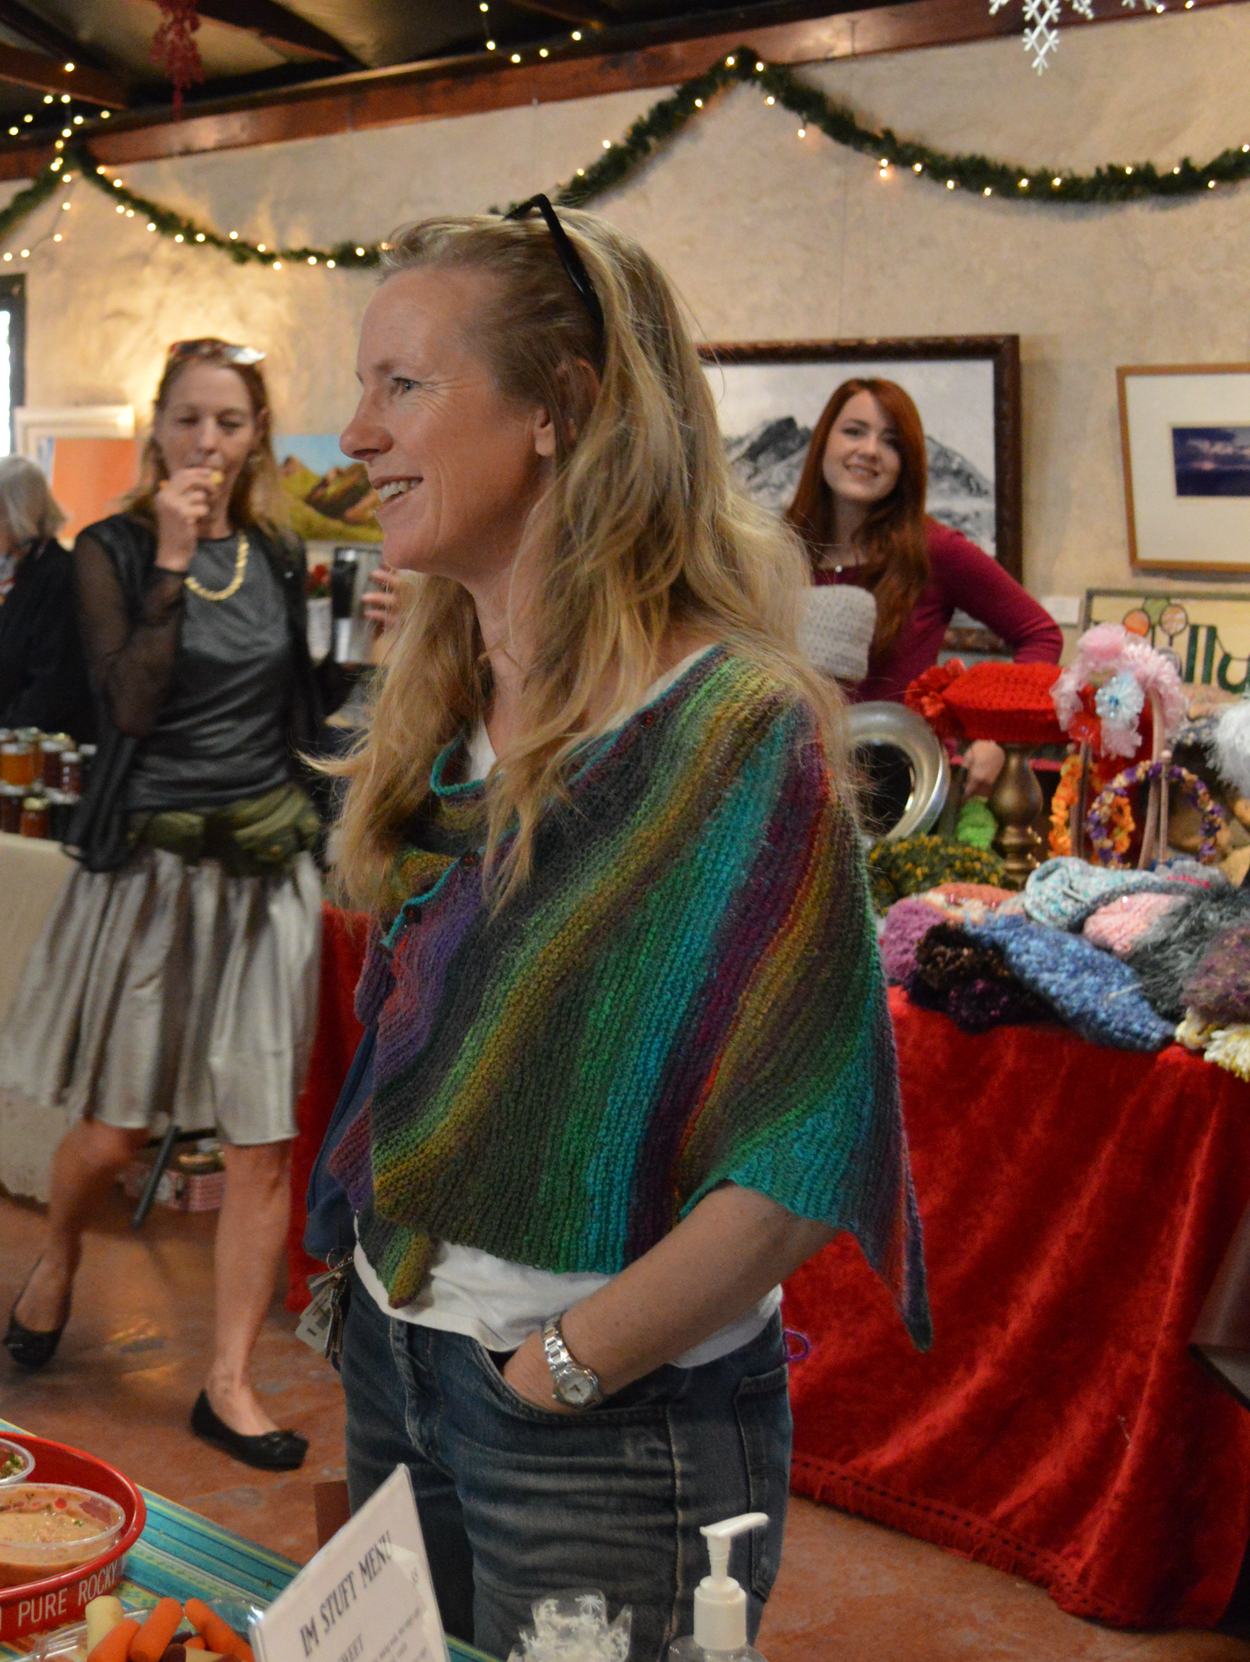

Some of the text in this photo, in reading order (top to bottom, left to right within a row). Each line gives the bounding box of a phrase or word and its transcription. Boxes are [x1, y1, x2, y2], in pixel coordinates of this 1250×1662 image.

[17, 1588, 68, 1627] PURE
[78, 1559, 118, 1607] ROCKY
[299, 1530, 393, 1657] IM STUFT MENU
